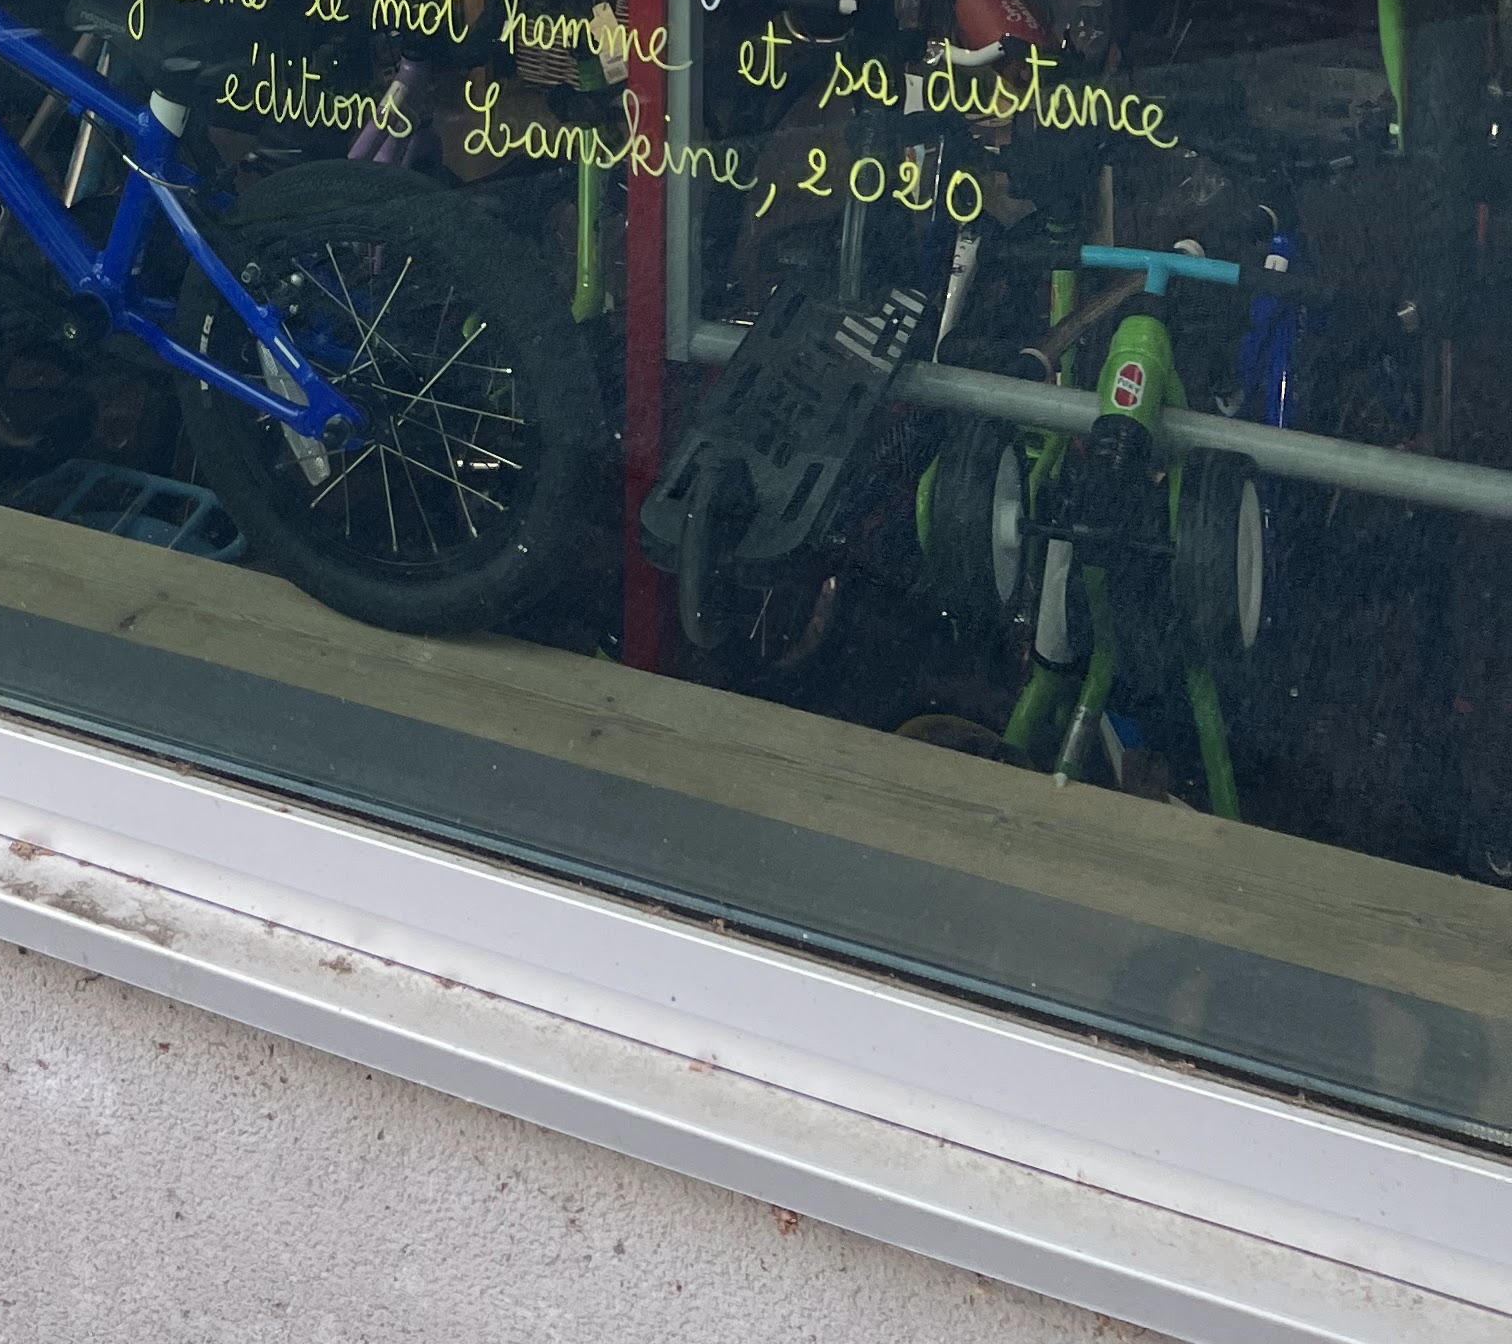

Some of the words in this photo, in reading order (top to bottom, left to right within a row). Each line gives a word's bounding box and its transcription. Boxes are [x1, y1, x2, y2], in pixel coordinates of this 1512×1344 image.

[215, 42, 414, 138] éditions
[797, 148, 983, 223] 2020
[738, 20, 792, 90] et
[818, 51, 899, 109] sa
[926, 37, 1179, 149] distance
